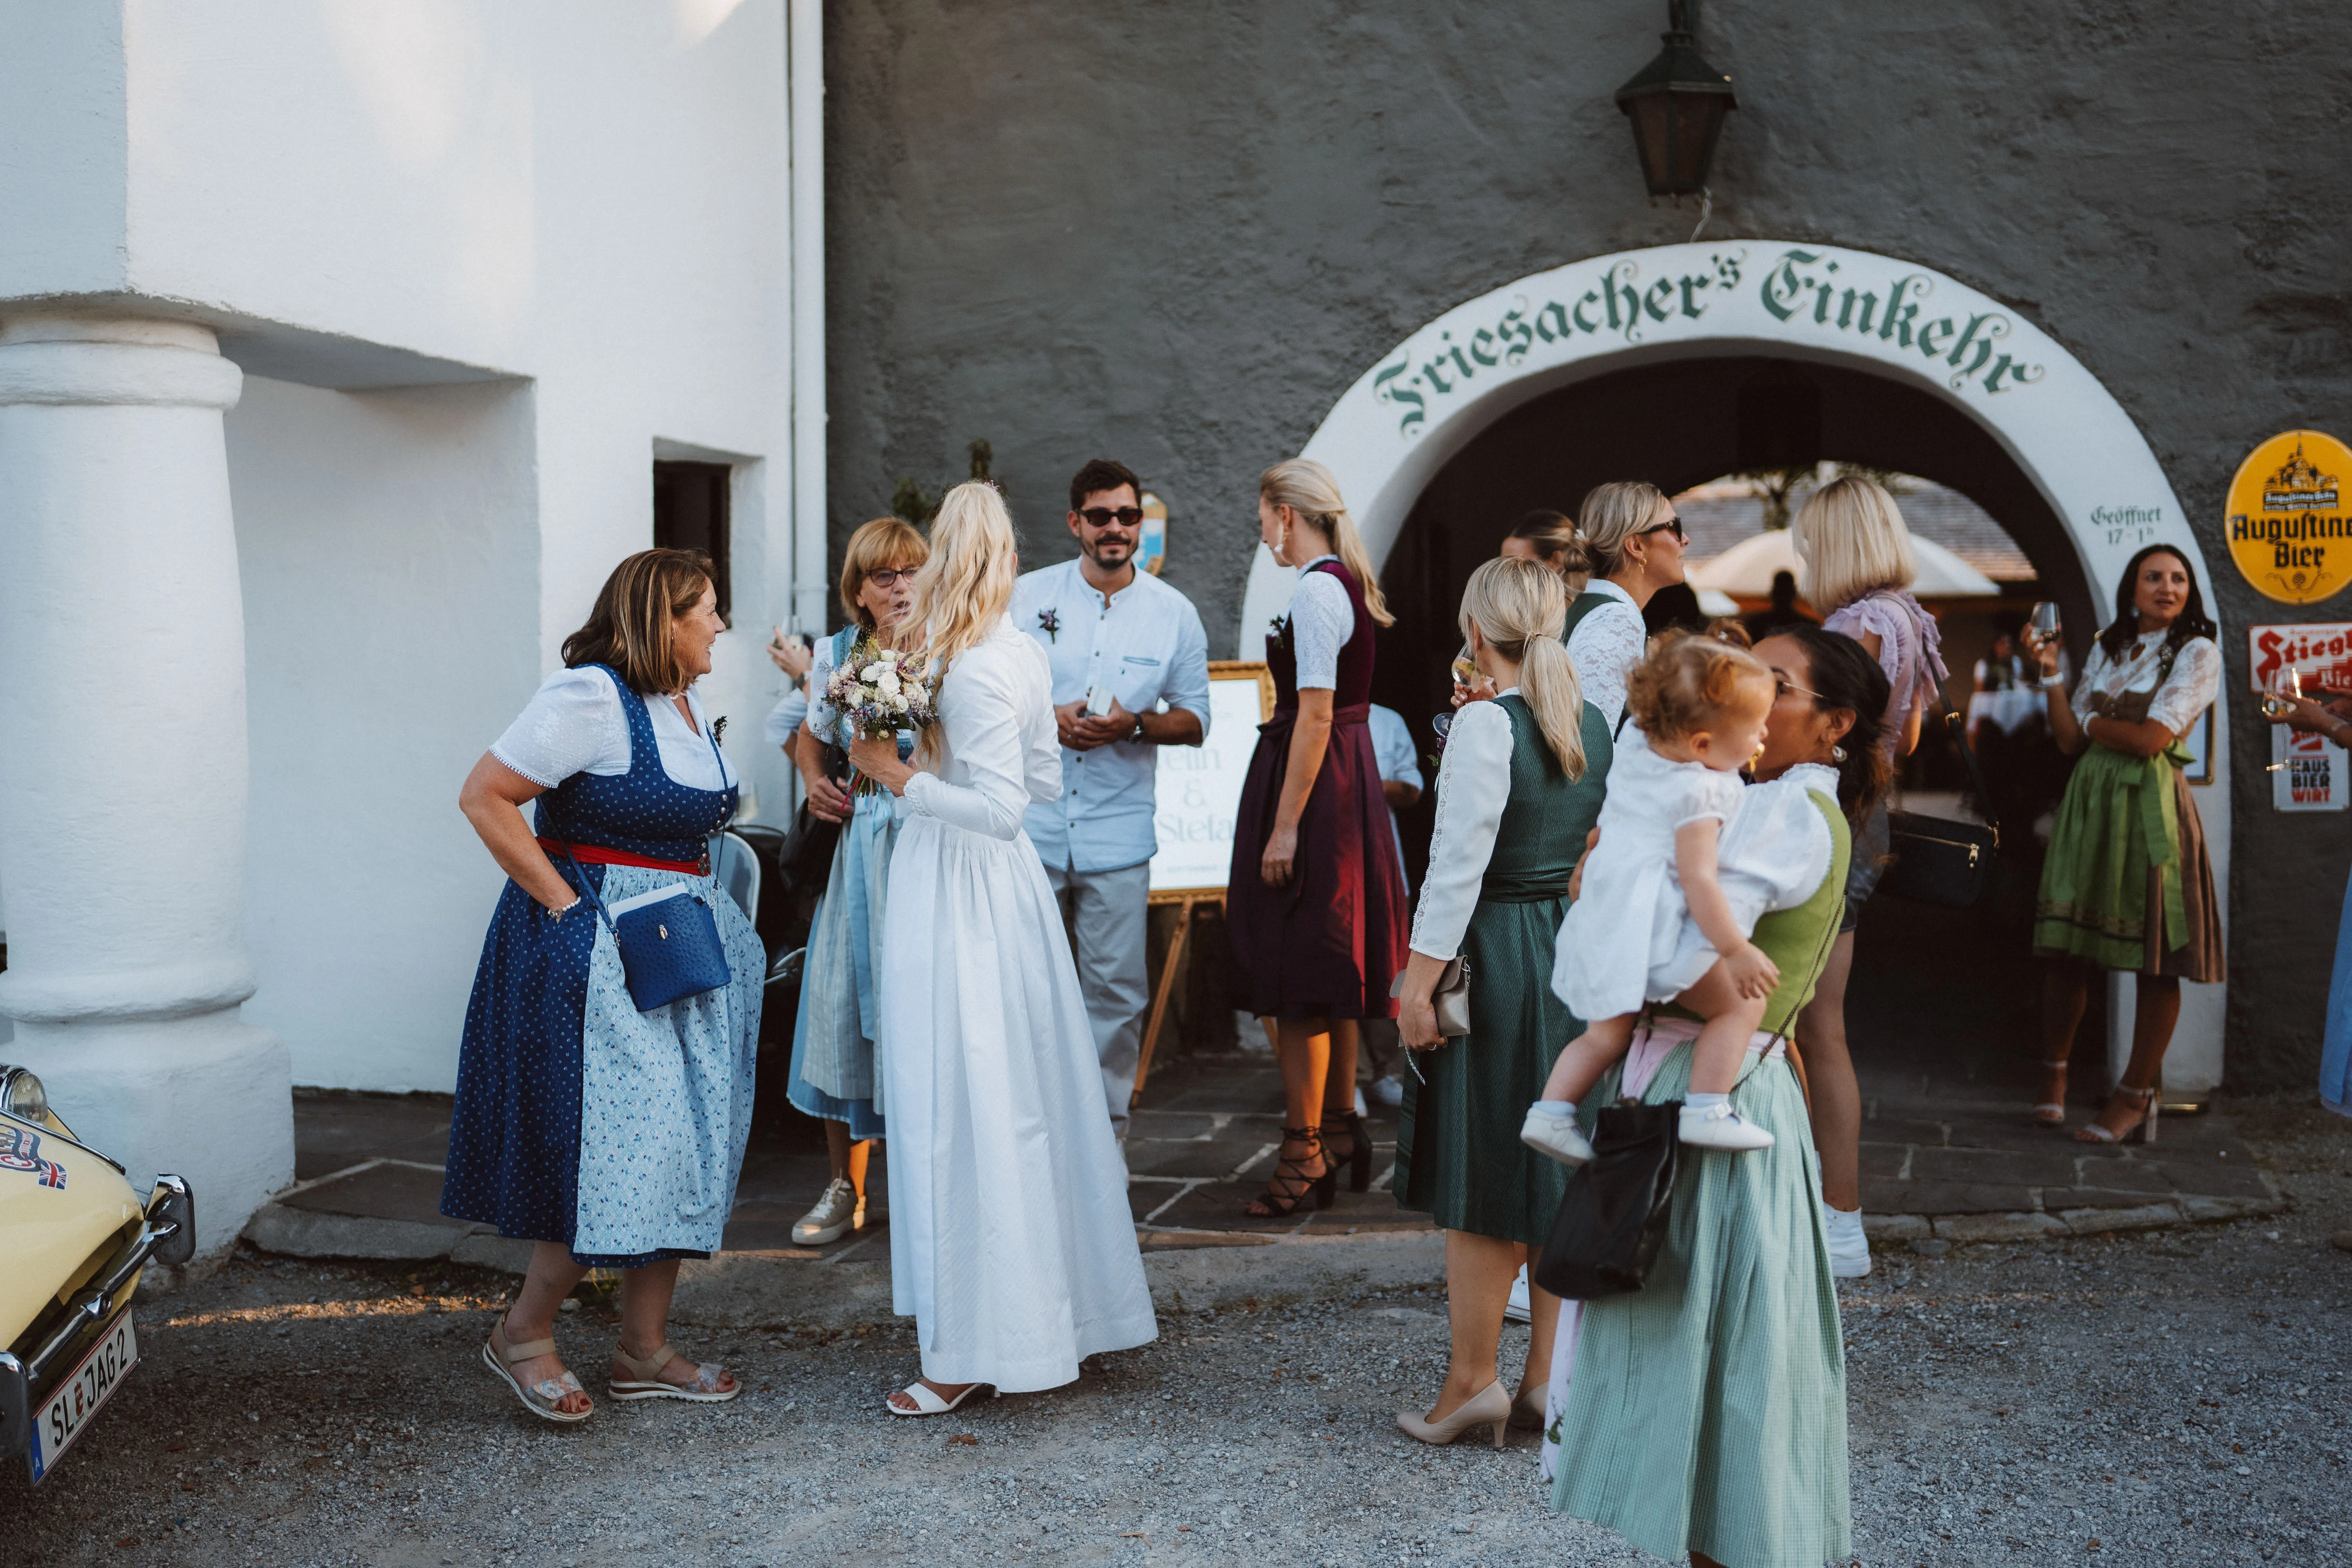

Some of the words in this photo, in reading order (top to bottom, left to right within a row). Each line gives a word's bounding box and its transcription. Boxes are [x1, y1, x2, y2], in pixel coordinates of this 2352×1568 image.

[1373, 248, 1747, 440] Friesacher's
[1759, 249, 2044, 395] Einkehr
[2090, 506, 2161, 525] Geöffnet
[2275, 541, 2325, 570] Bier
[2291, 759, 2330, 773] HAUS
[2291, 773, 2330, 787] BIER
[2292, 789, 2330, 803] WIRT
[51, 1394, 74, 1448] SL
[84, 1341, 115, 1408] JAG
[117, 1328, 128, 1371] 2
[35, 1457, 40, 1472] A
